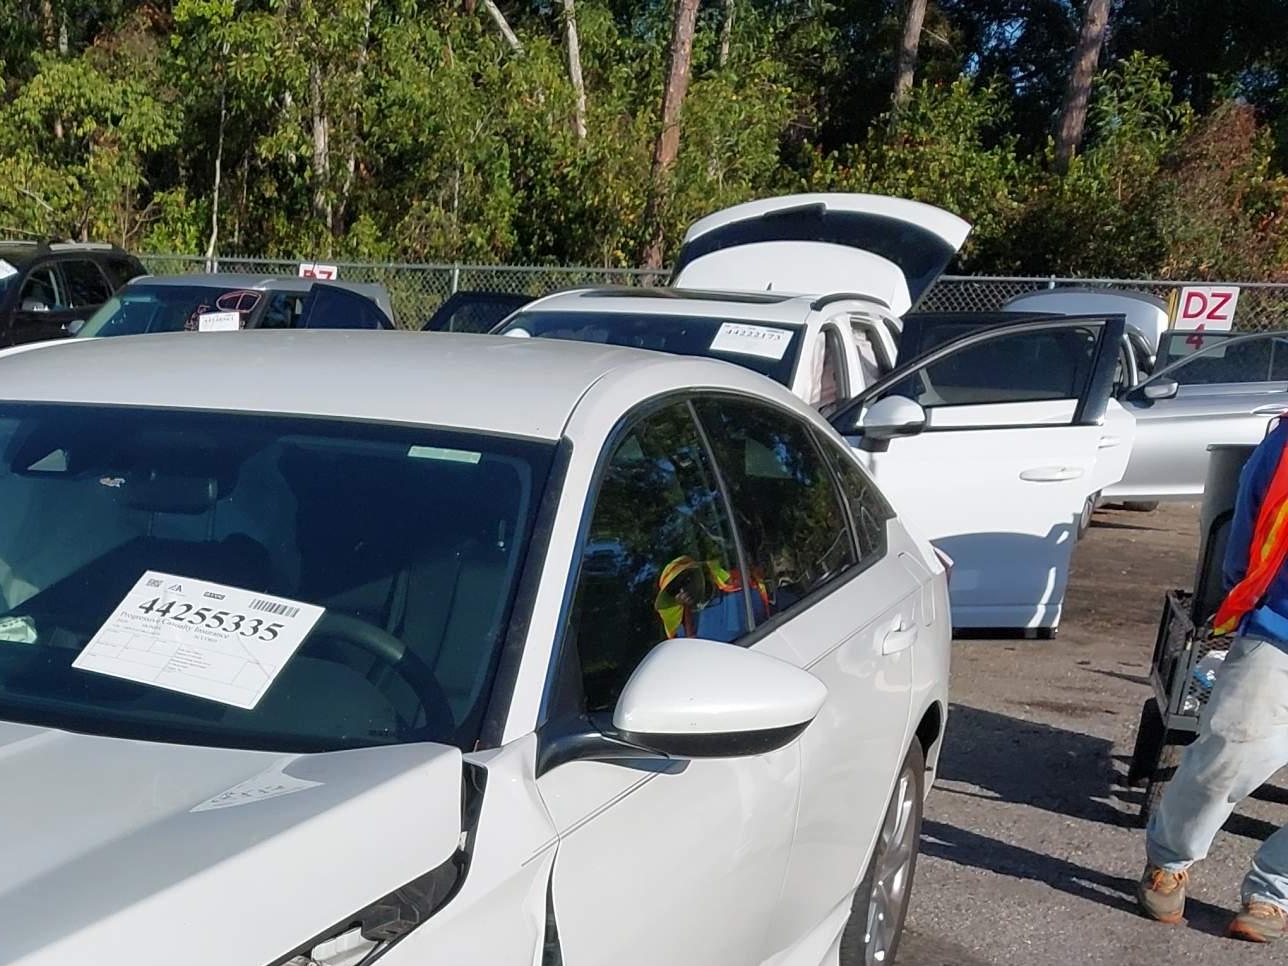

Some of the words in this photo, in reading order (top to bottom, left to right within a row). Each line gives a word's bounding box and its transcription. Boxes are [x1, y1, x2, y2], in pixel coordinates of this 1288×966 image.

[1182, 291, 1233, 320] DZ
[1185, 323, 1206, 350] 4
[138, 597, 285, 641] 44255335
